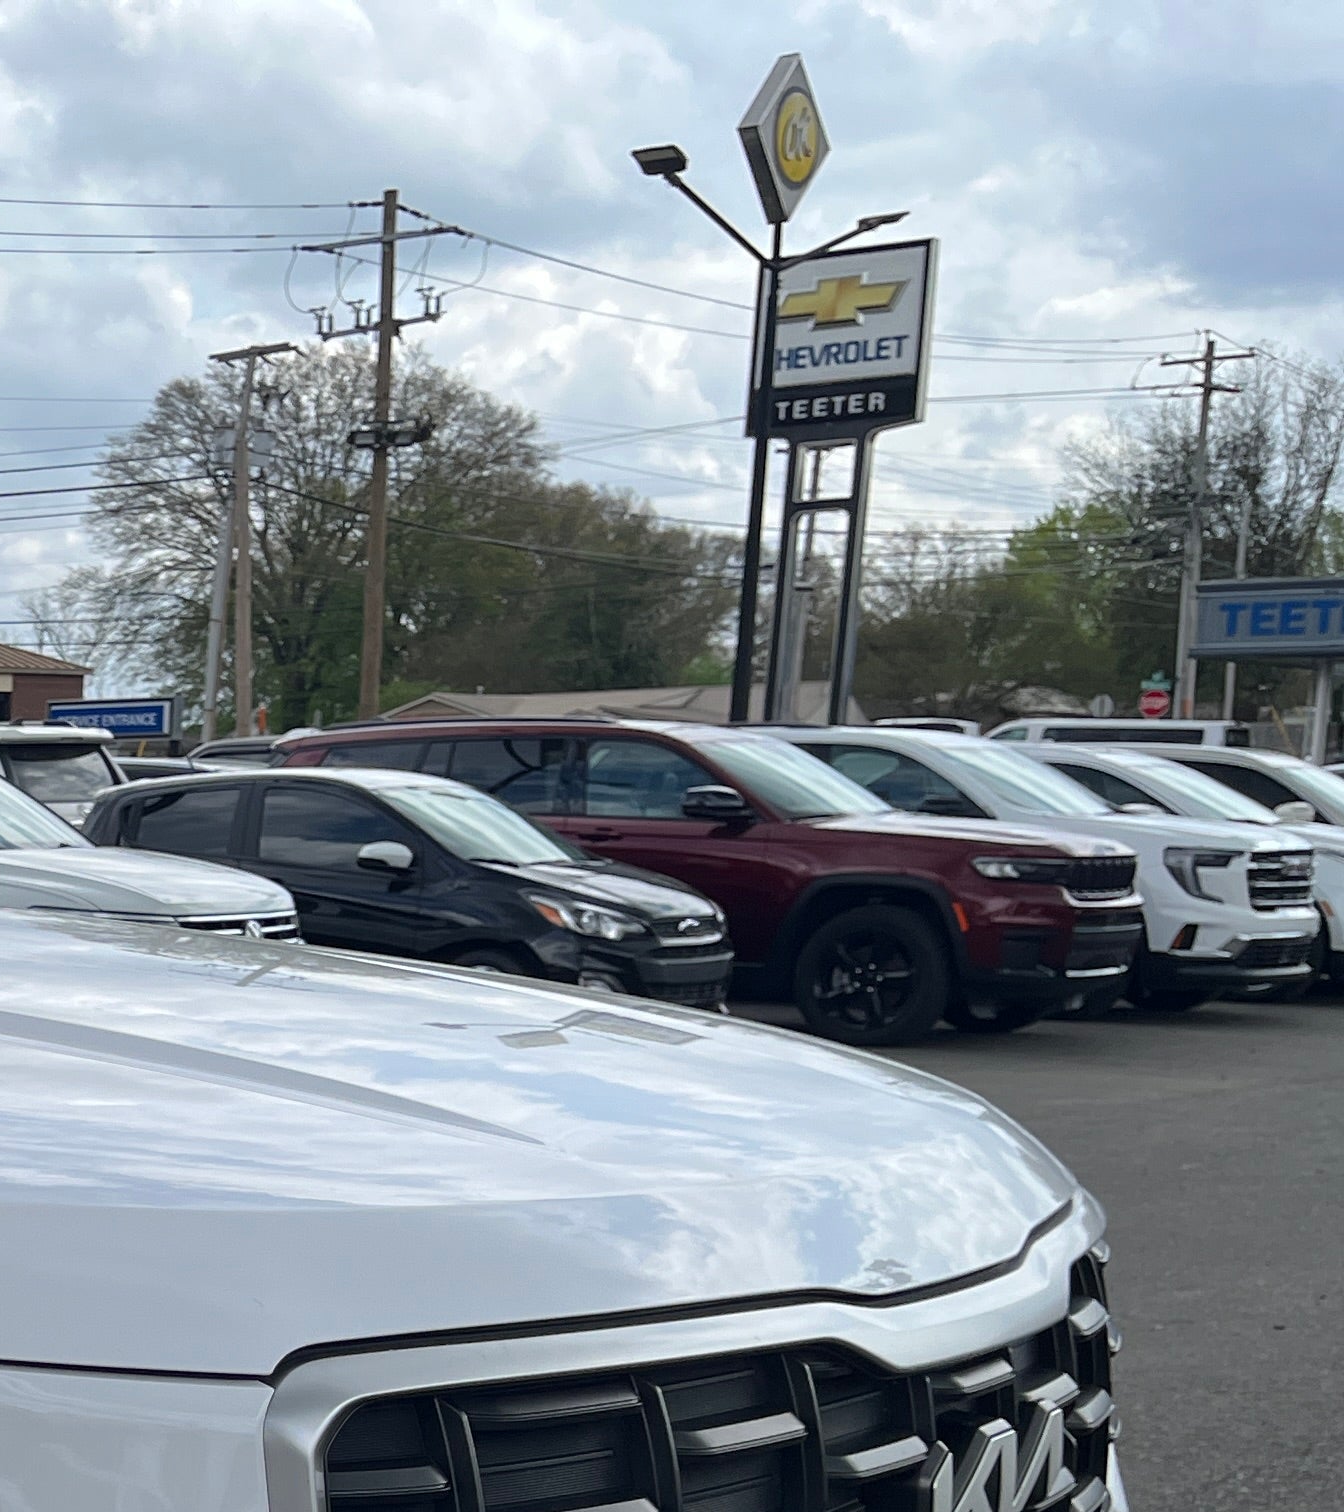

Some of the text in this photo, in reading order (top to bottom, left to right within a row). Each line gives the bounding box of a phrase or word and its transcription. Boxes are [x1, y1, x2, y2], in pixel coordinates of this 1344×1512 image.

[775, 334, 910, 371] HEVROLET
[774, 391, 887, 421] TEETER
[1220, 599, 1344, 637] TEET
[101, 711, 158, 727] ENTRANCE
